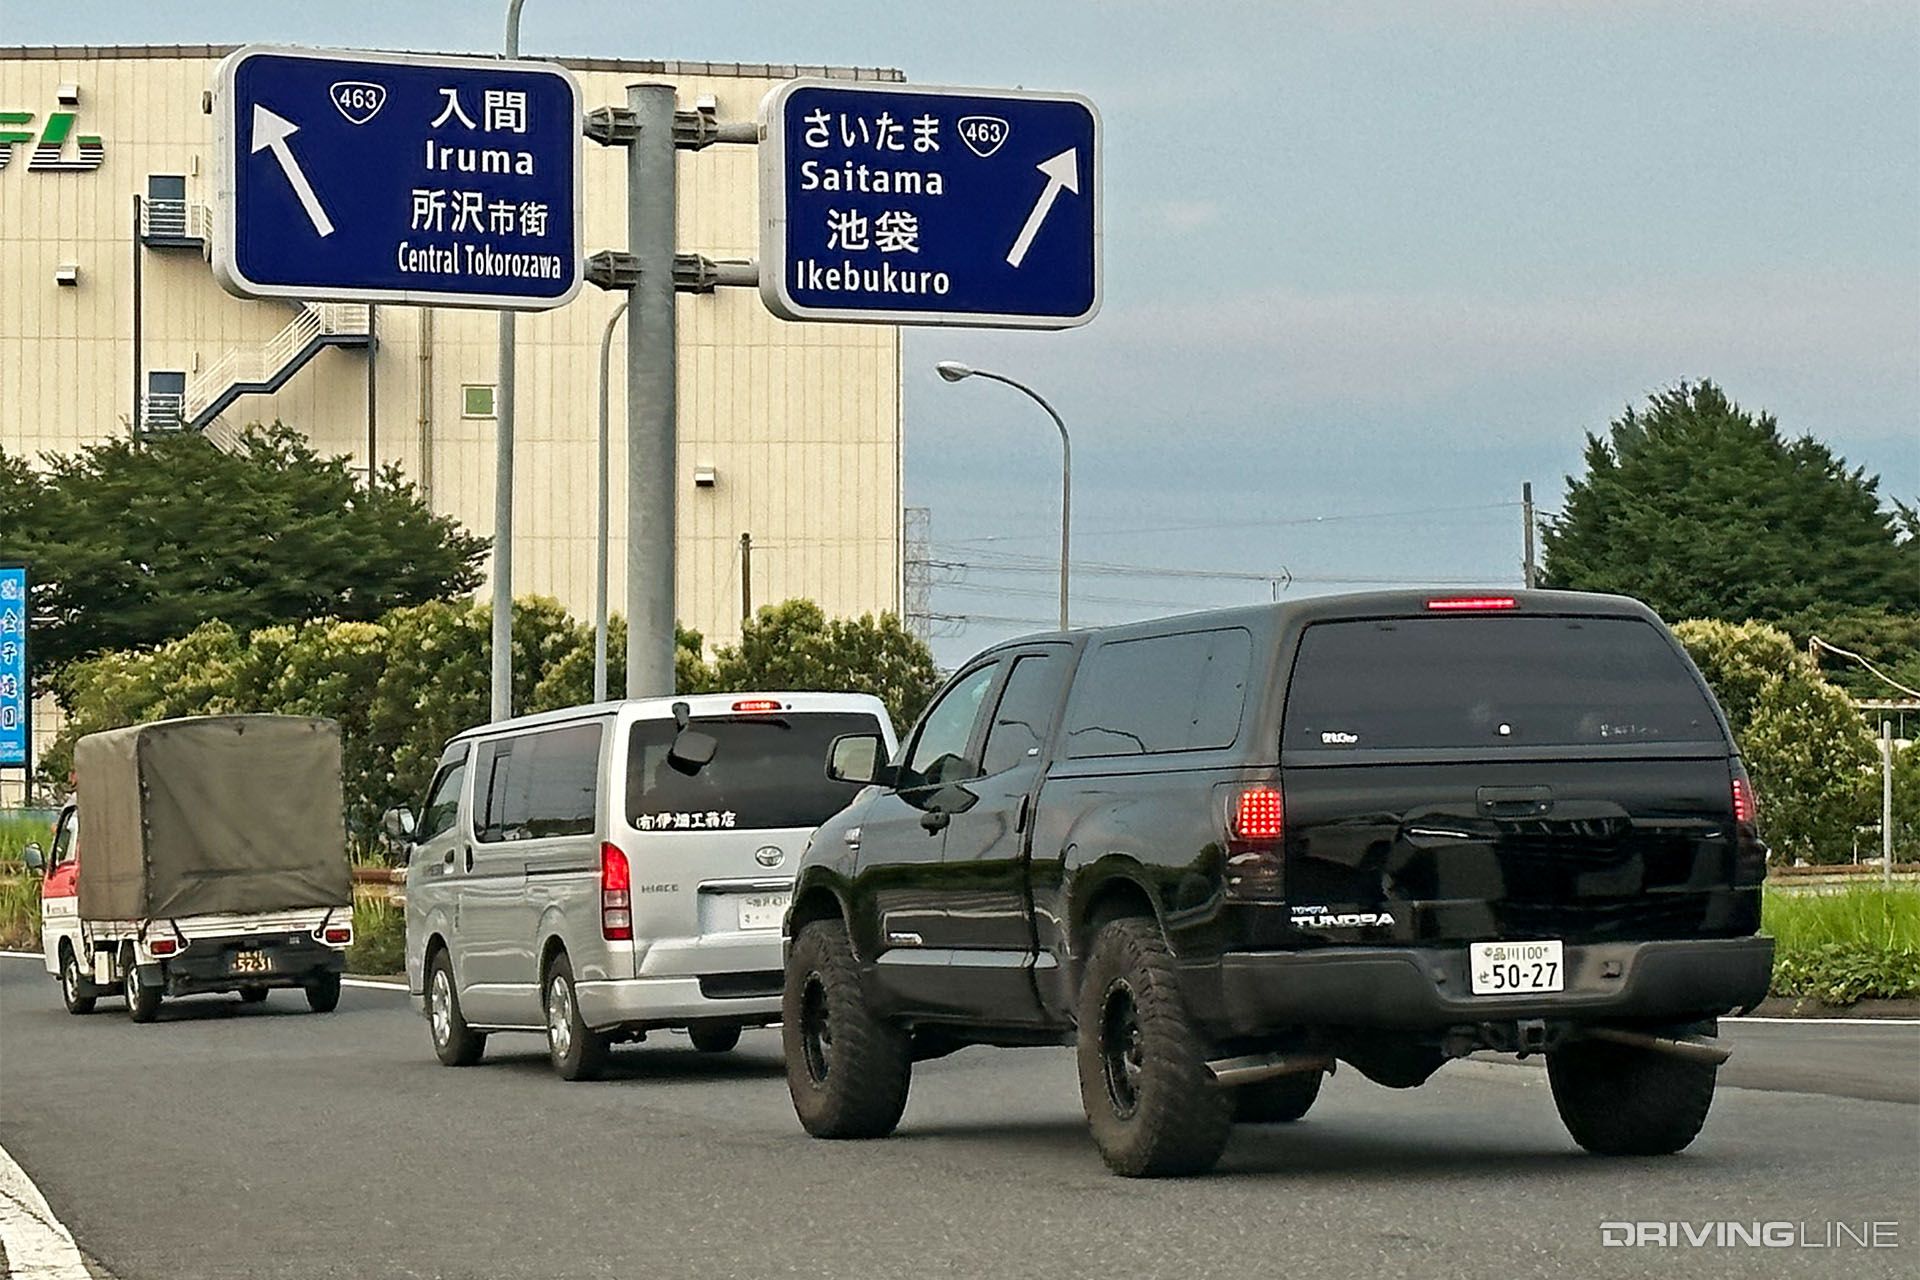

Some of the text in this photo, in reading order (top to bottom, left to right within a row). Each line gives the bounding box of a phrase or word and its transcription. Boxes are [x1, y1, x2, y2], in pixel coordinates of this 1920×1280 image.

[339, 88, 377, 109] 463
[431, 88, 527, 133] 入間
[804, 108, 940, 152] さいたま
[966, 122, 1001, 143] 463
[426, 140, 534, 175] Iruma
[801, 160, 943, 195] Saitama
[411, 189, 548, 237] 所沢市街
[826, 208, 919, 254] 池袋
[398, 241, 561, 279] Central Tokorozawa
[797, 258, 950, 295] Ikebukuro
[1290, 913, 1395, 927] TUNDRA
[1291, 905, 1328, 914] TOYOTA
[1493, 962, 1558, 988] 50-27
